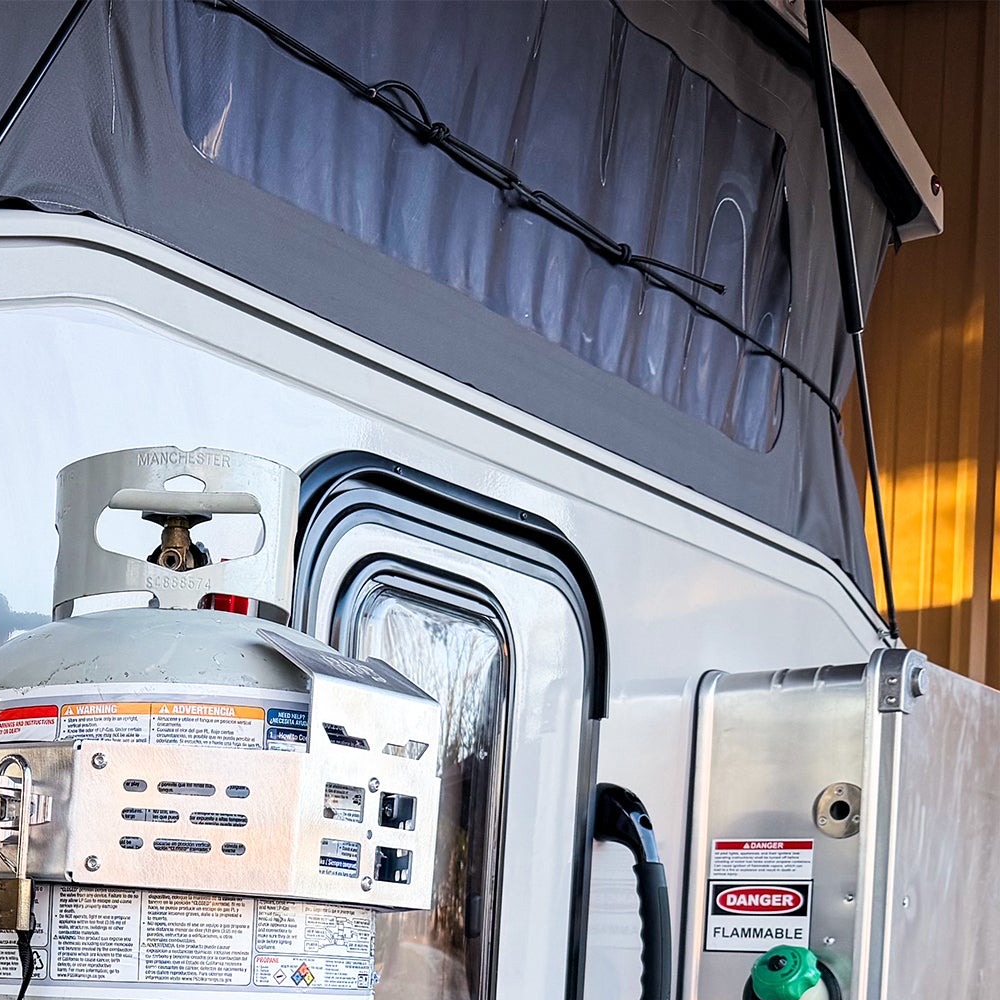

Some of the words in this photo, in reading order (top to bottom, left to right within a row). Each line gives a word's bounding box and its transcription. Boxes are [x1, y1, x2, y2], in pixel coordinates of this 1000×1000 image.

[137, 452, 231, 468] MANCHESTER
[76, 704, 118, 714] WARNING
[172, 705, 236, 717] ADVERTENCIA
[726, 894, 794, 906] DANGER
[713, 927, 803, 939] FLAMMABLE
